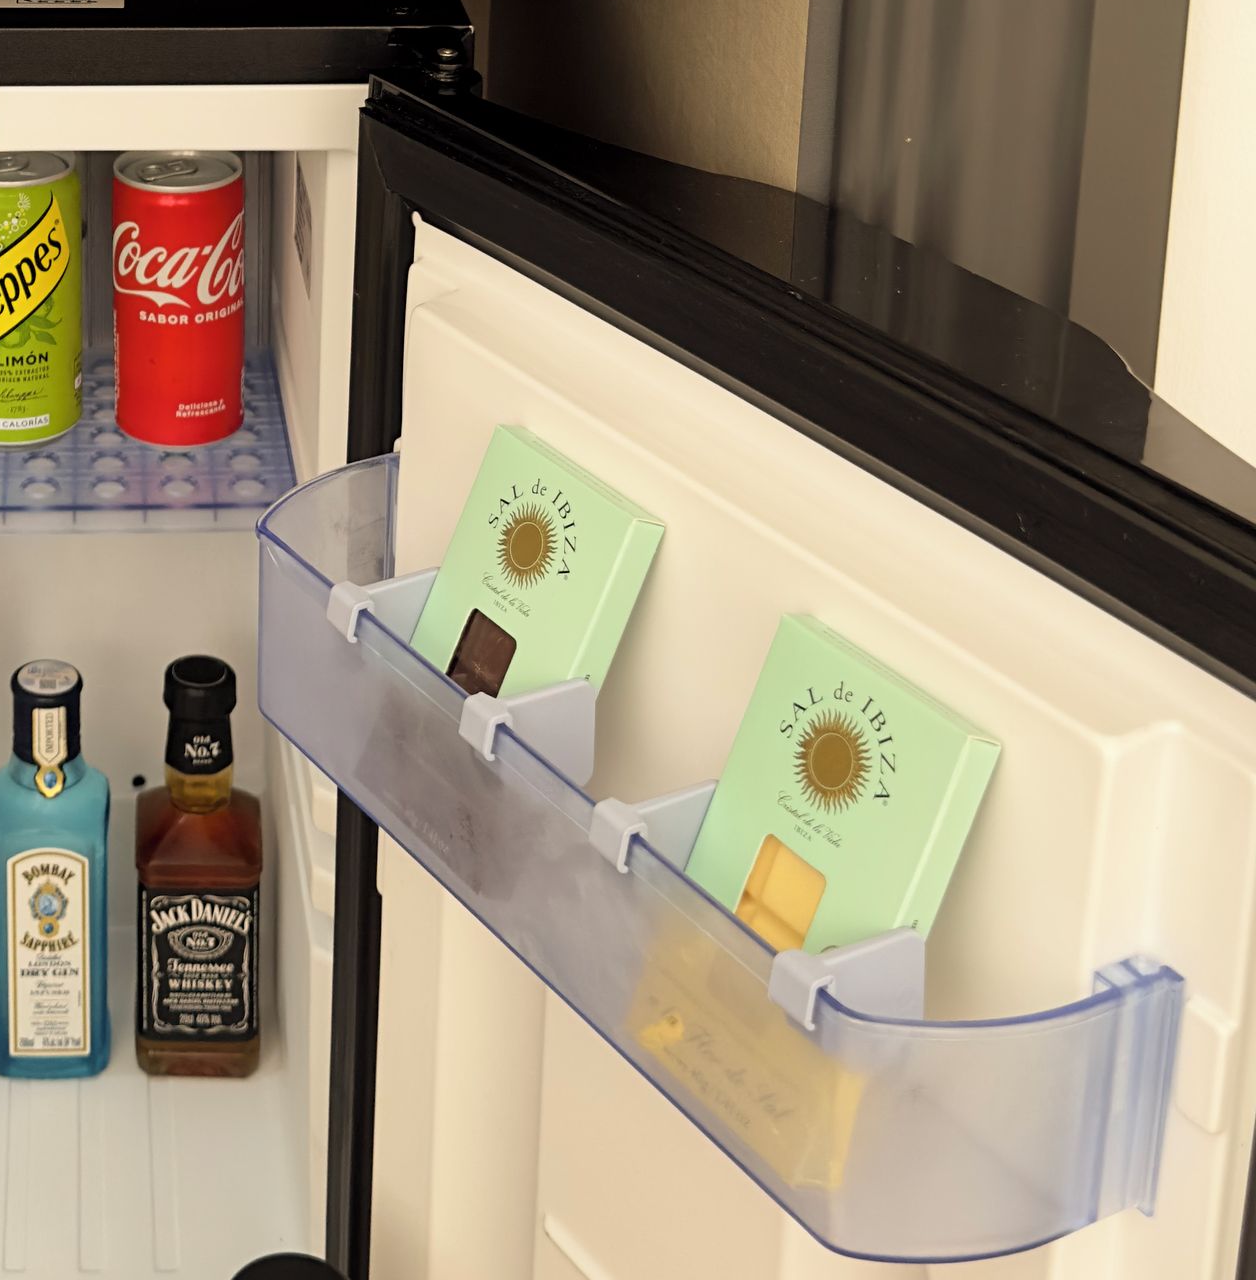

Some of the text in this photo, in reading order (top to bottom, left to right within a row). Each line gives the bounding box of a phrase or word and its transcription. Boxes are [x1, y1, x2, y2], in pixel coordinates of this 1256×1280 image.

[113, 208, 245, 305] Coca-Co
[139, 300, 244, 325] SABOR ORIGINA
[2, 416, 49, 428] CALORÍAS
[488, 478, 577, 576] SAL de IBIZA
[183, 741, 222, 759] No.7
[192, 735, 211, 744] Old
[780, 680, 897, 801] SAL de IBIZA
[21, 863, 76, 886] BOMBAY
[149, 897, 252, 935] JACK DANIEL'S
[19, 929, 80, 952] SAPPHIRE
[19, 967, 79, 977] DRY GIN
[166, 957, 235, 973] Tennessee
[168, 978, 233, 991] WHISKEY
